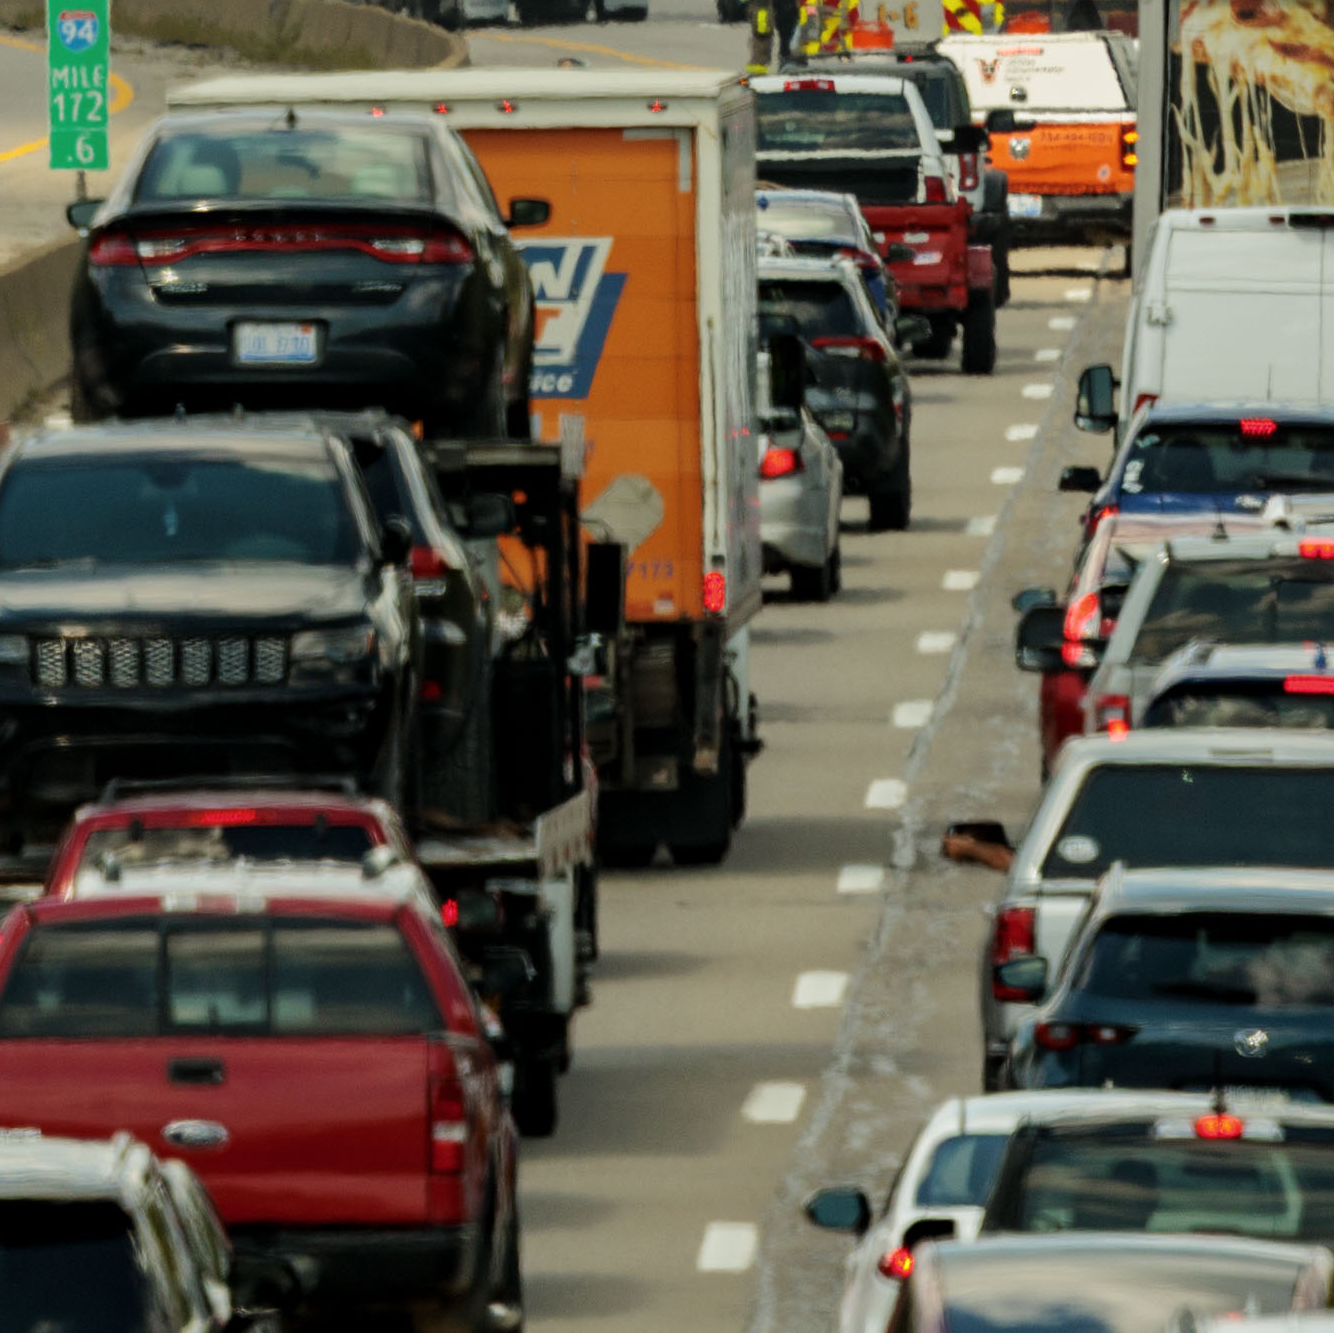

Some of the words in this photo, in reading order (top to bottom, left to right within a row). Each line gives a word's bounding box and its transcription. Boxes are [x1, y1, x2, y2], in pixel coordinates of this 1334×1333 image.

[61, 19, 94, 44] 94
[52, 66, 104, 89] MILE
[53, 90, 104, 122] 172
[68, 134, 95, 164] .6
